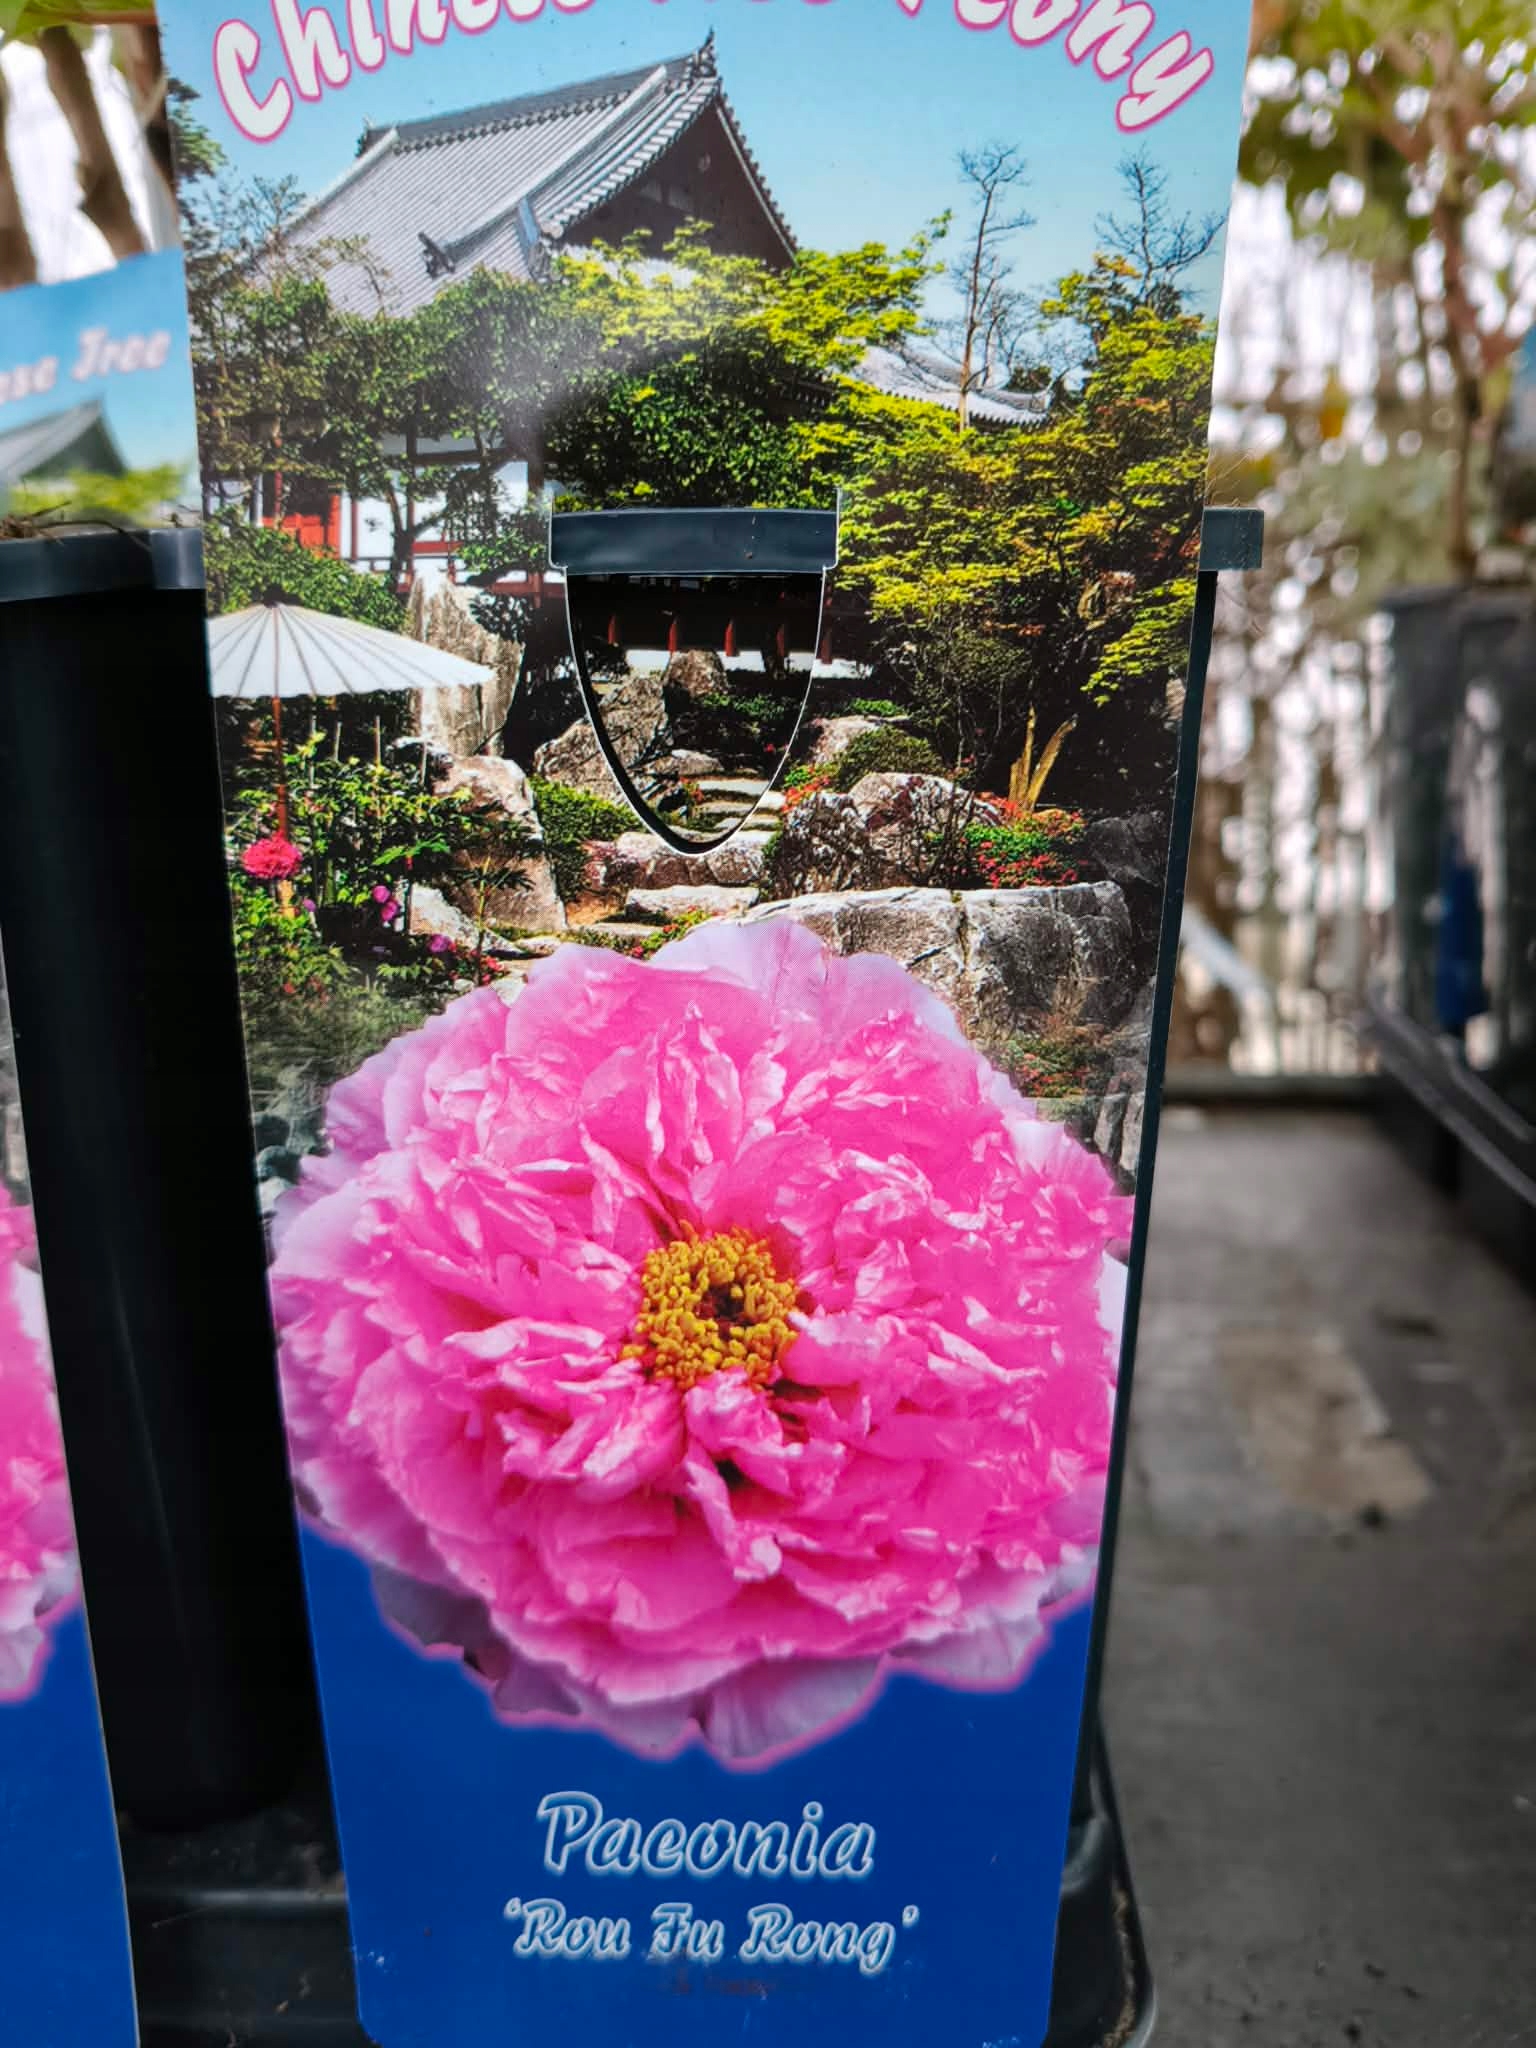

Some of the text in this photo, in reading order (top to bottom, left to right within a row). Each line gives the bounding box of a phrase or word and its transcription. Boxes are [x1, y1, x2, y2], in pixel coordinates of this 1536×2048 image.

[72, 328, 171, 381] Tree
[536, 1790, 877, 1879] Paeonia
[649, 1902, 726, 1961] Fu
